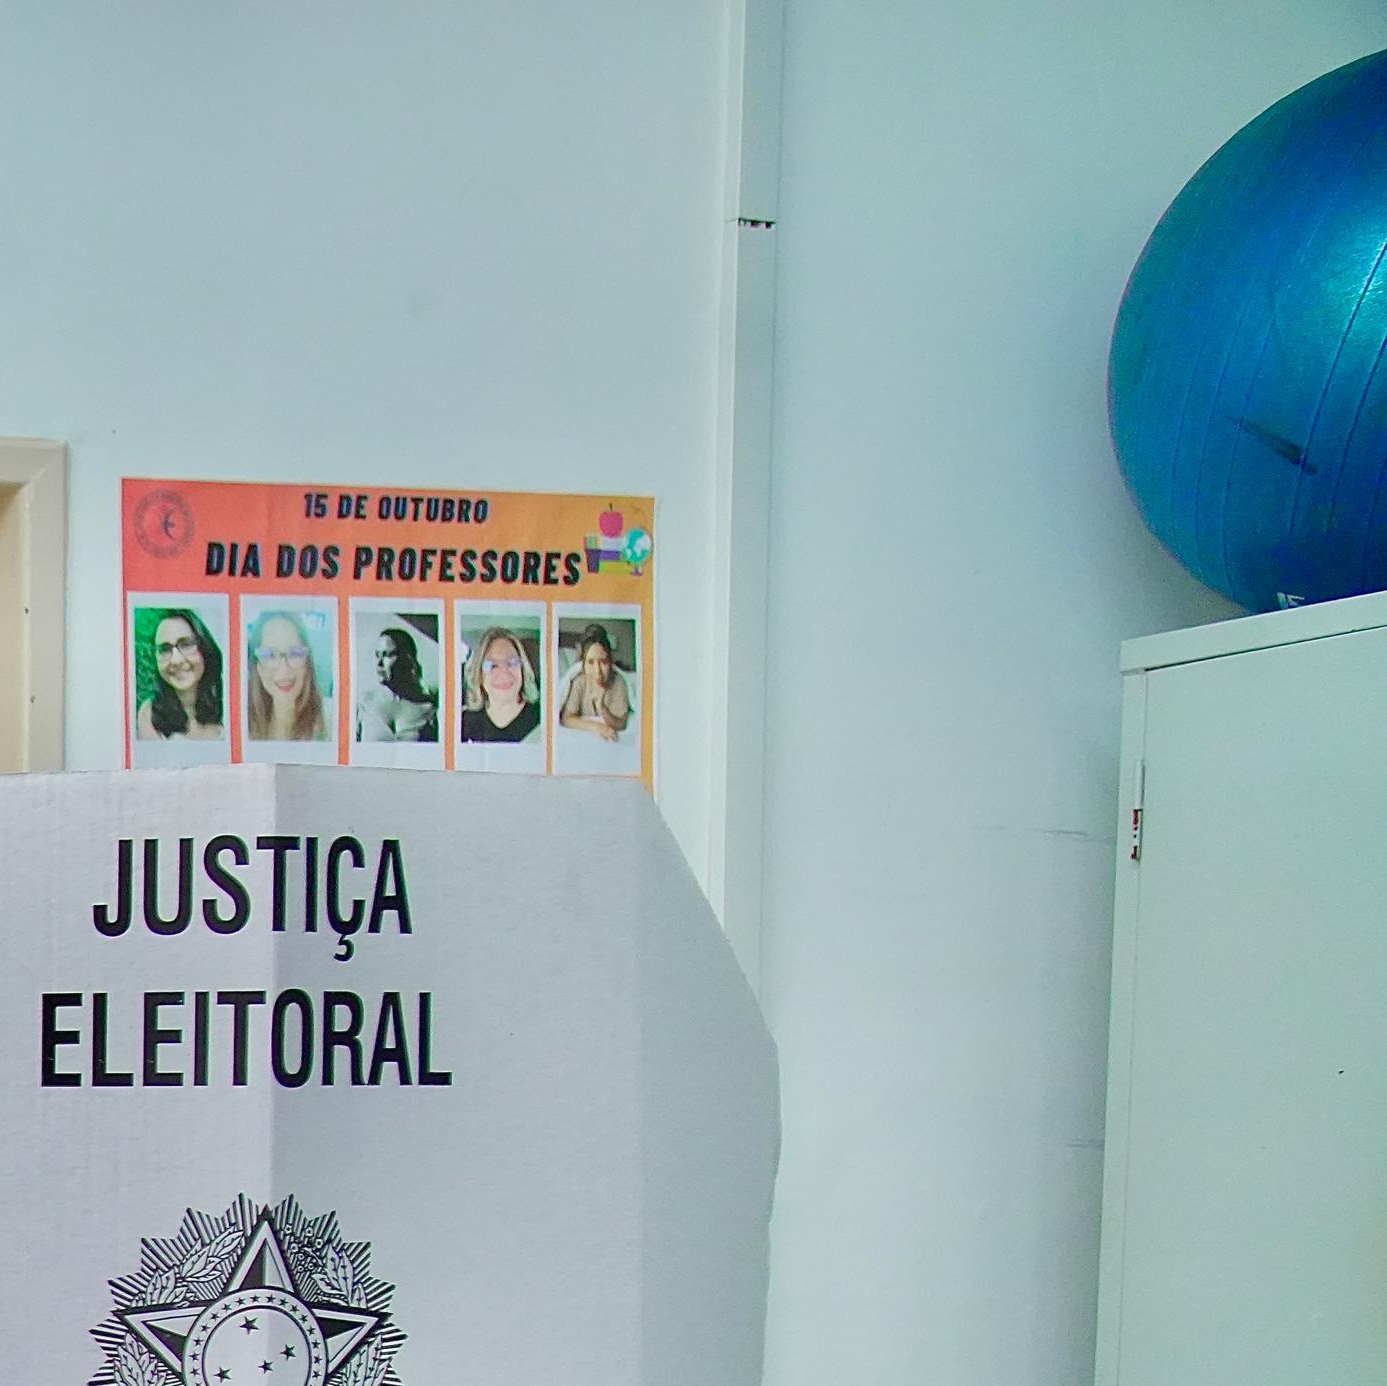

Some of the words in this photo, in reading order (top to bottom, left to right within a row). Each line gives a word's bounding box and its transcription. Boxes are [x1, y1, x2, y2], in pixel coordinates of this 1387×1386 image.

[304, 491, 328, 518] 15
[339, 494, 368, 521] DE
[378, 496, 489, 524] OUTUBRO
[206, 542, 262, 578] DIA
[276, 545, 339, 579] DOS
[353, 548, 583, 585] PROFESSORES
[93, 834, 413, 962] JUSTIÇA
[41, 989, 453, 1087] ELEITORAL
